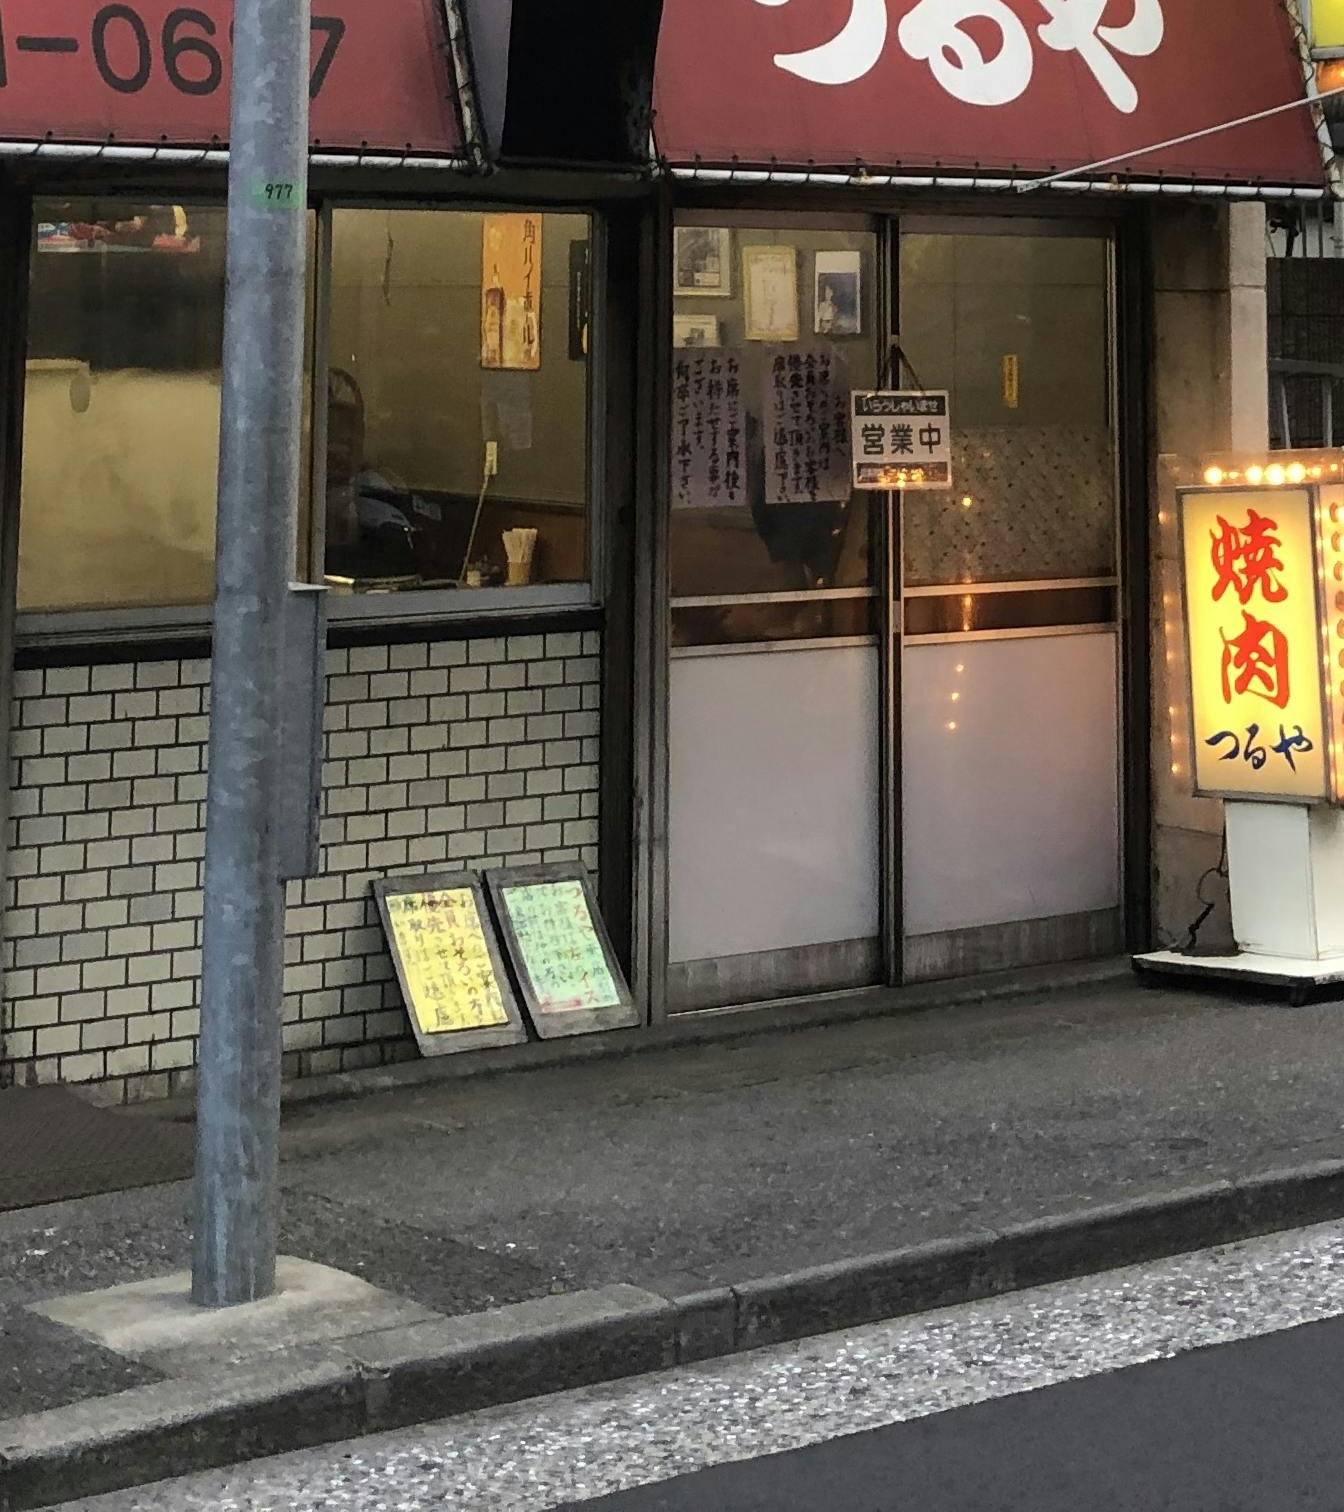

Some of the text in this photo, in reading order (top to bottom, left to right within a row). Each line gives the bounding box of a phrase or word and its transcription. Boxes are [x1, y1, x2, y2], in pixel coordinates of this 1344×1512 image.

[265, 183, 293, 200] 977
[862, 423, 941, 456] 営業中
[1210, 508, 1289, 710] 焼肉
[1204, 723, 1313, 774] つるや
